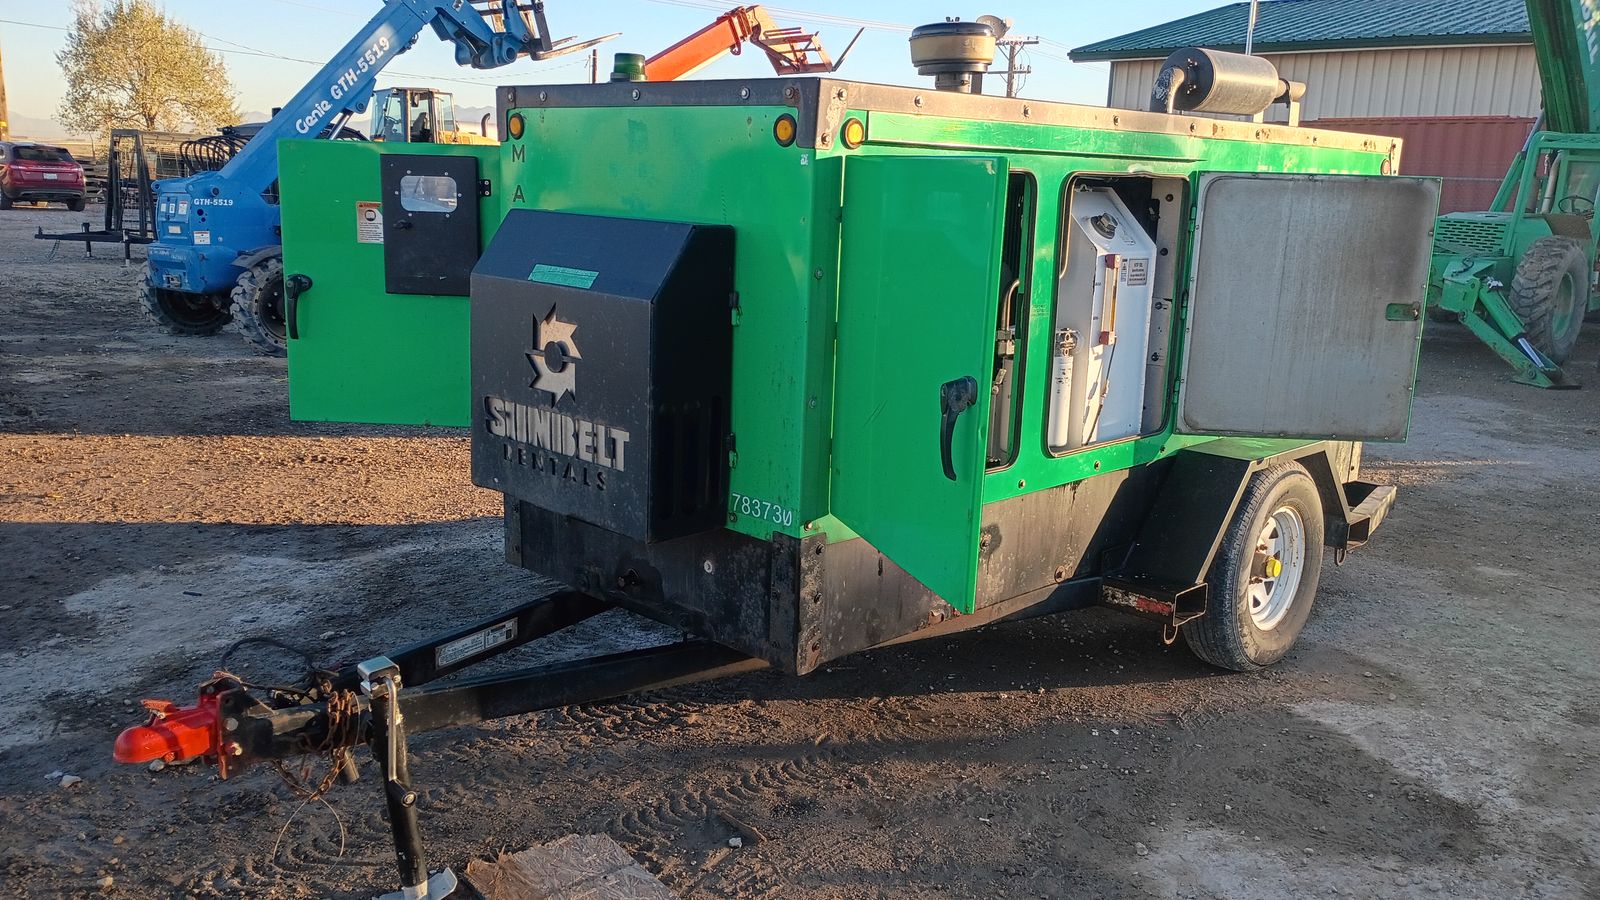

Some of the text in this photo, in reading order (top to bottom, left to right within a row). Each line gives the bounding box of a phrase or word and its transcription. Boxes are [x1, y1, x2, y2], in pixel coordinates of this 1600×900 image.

[295, 36, 390, 134] Genie GTH-5519
[193, 198, 234, 206] GTH-5519
[484, 395, 630, 472] SUNBELT
[503, 443, 607, 491] RENTALS
[731, 493, 792, 527] 783730
